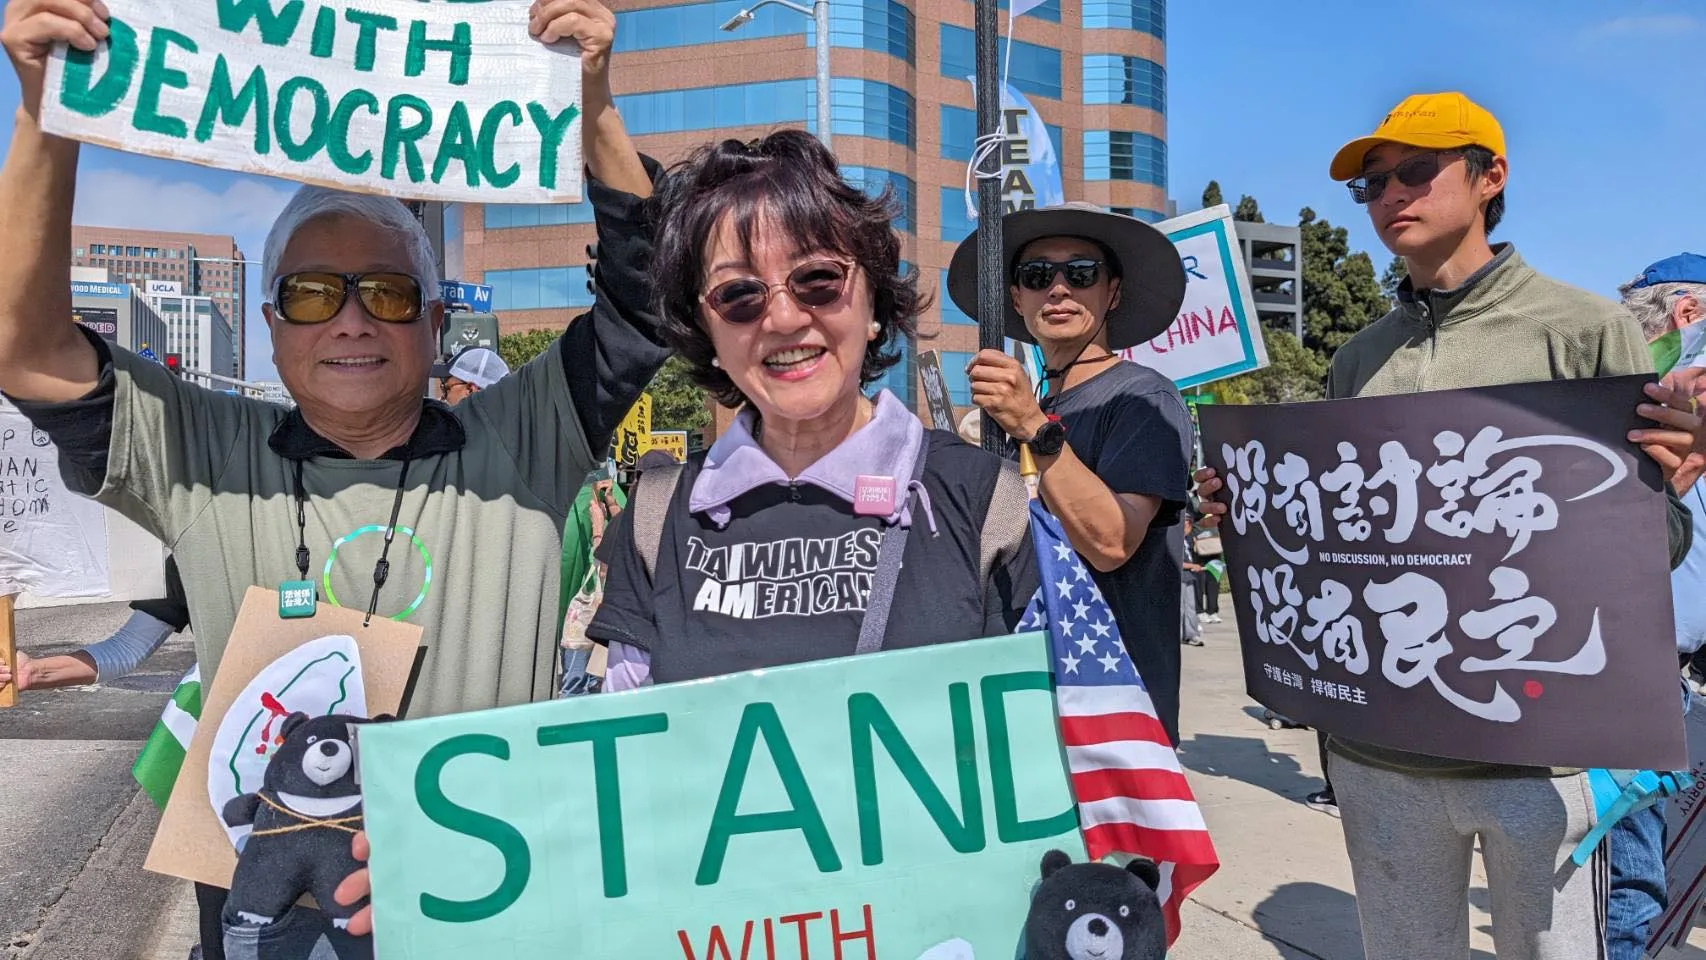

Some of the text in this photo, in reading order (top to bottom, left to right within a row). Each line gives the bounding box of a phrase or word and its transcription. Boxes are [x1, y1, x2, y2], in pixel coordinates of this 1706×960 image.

[218, 0, 472, 85] WITH
[59, 18, 580, 189] DEMOCRACY
[89, 285, 122, 295] MEDICAL
[152, 284, 175, 293] UCLA
[474, 286, 489, 302] Av
[0, 457, 37, 477] AN
[685, 528, 902, 583] TAIWANES
[1318, 551, 1472, 567] NO DISCUSSION, NO DEMOCRACY
[1263, 662, 1368, 705] 守護台灣 捍衛民主
[413, 671, 1079, 923] STAND
[677, 904, 876, 960] WITH
